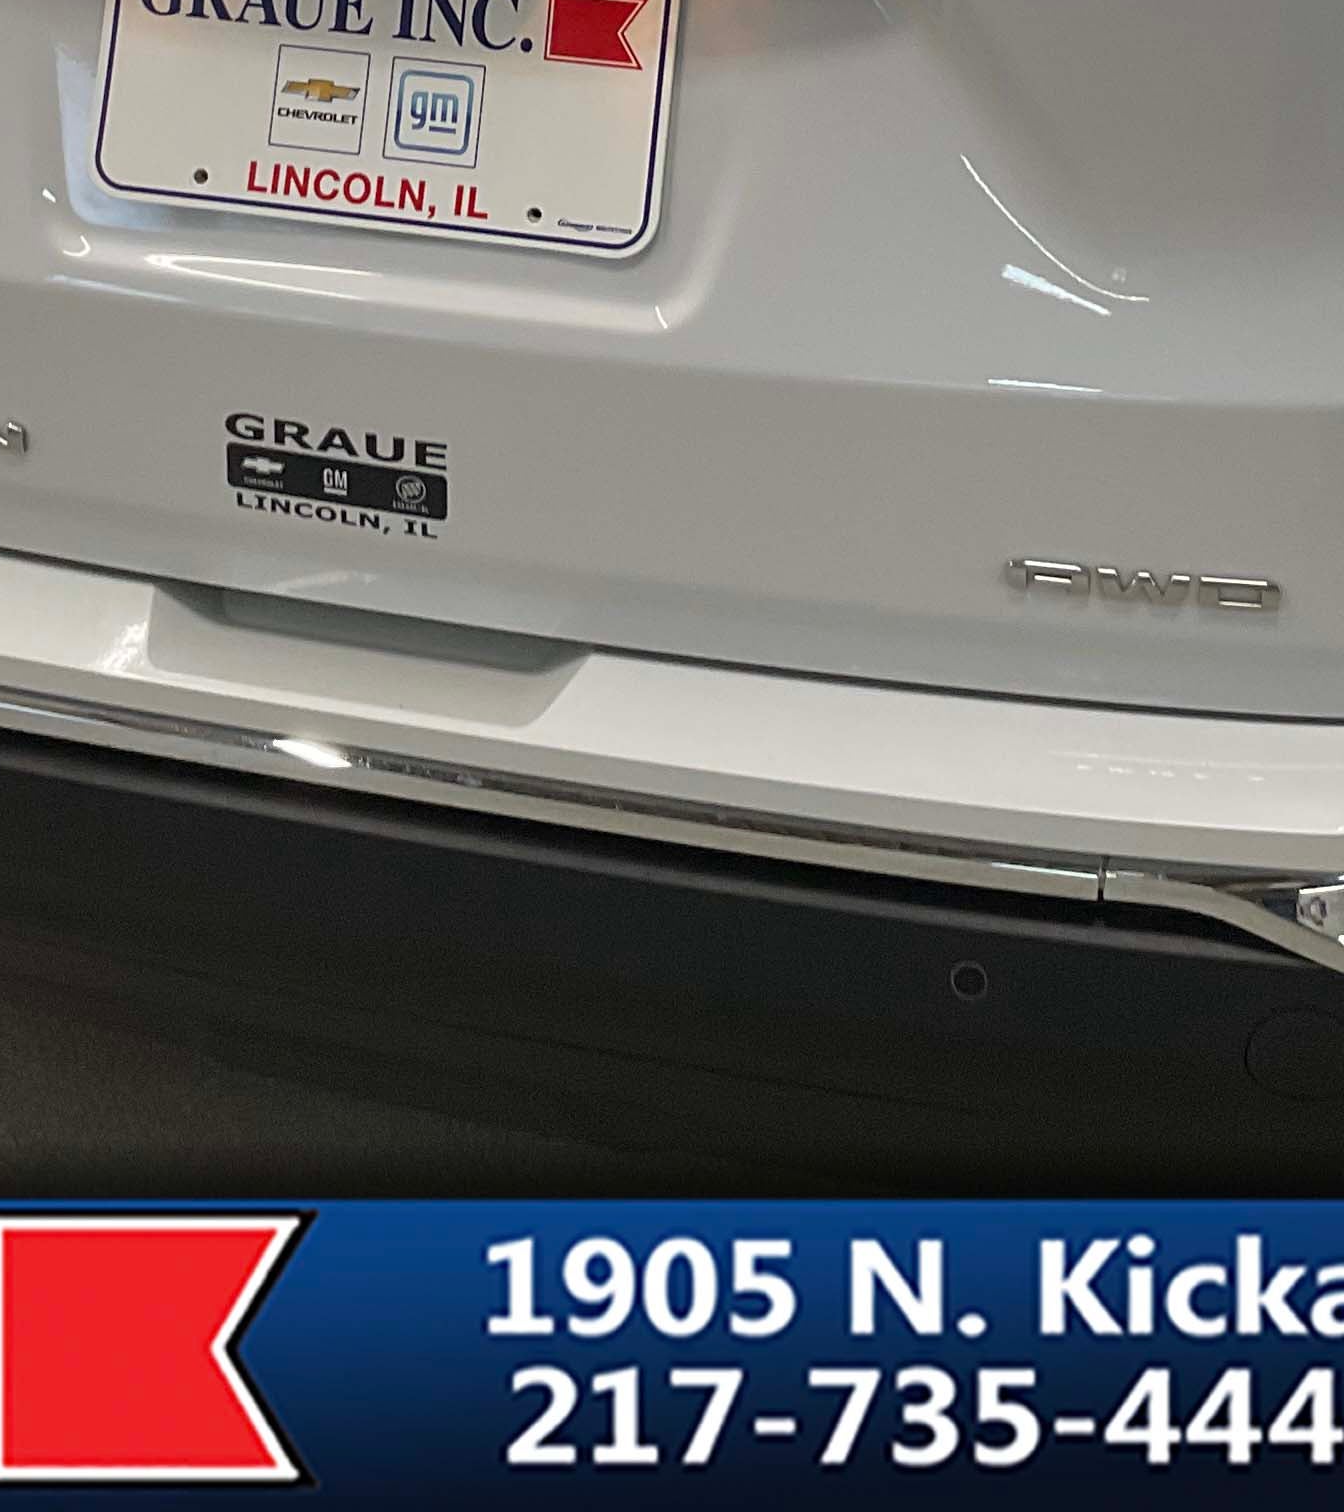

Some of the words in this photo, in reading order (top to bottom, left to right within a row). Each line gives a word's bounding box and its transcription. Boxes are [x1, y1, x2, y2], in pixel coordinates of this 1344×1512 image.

[277, 107, 359, 125] CHEVROLET
[409, 90, 459, 133] gm
[247, 160, 436, 220] LINCOLN,
[454, 186, 488, 220] IL
[224, 412, 448, 471] GRAUE
[323, 467, 348, 494] GM
[236, 492, 391, 535] LINCOLN,
[403, 518, 438, 539] IL
[1005, 558, 1282, 610] AWD
